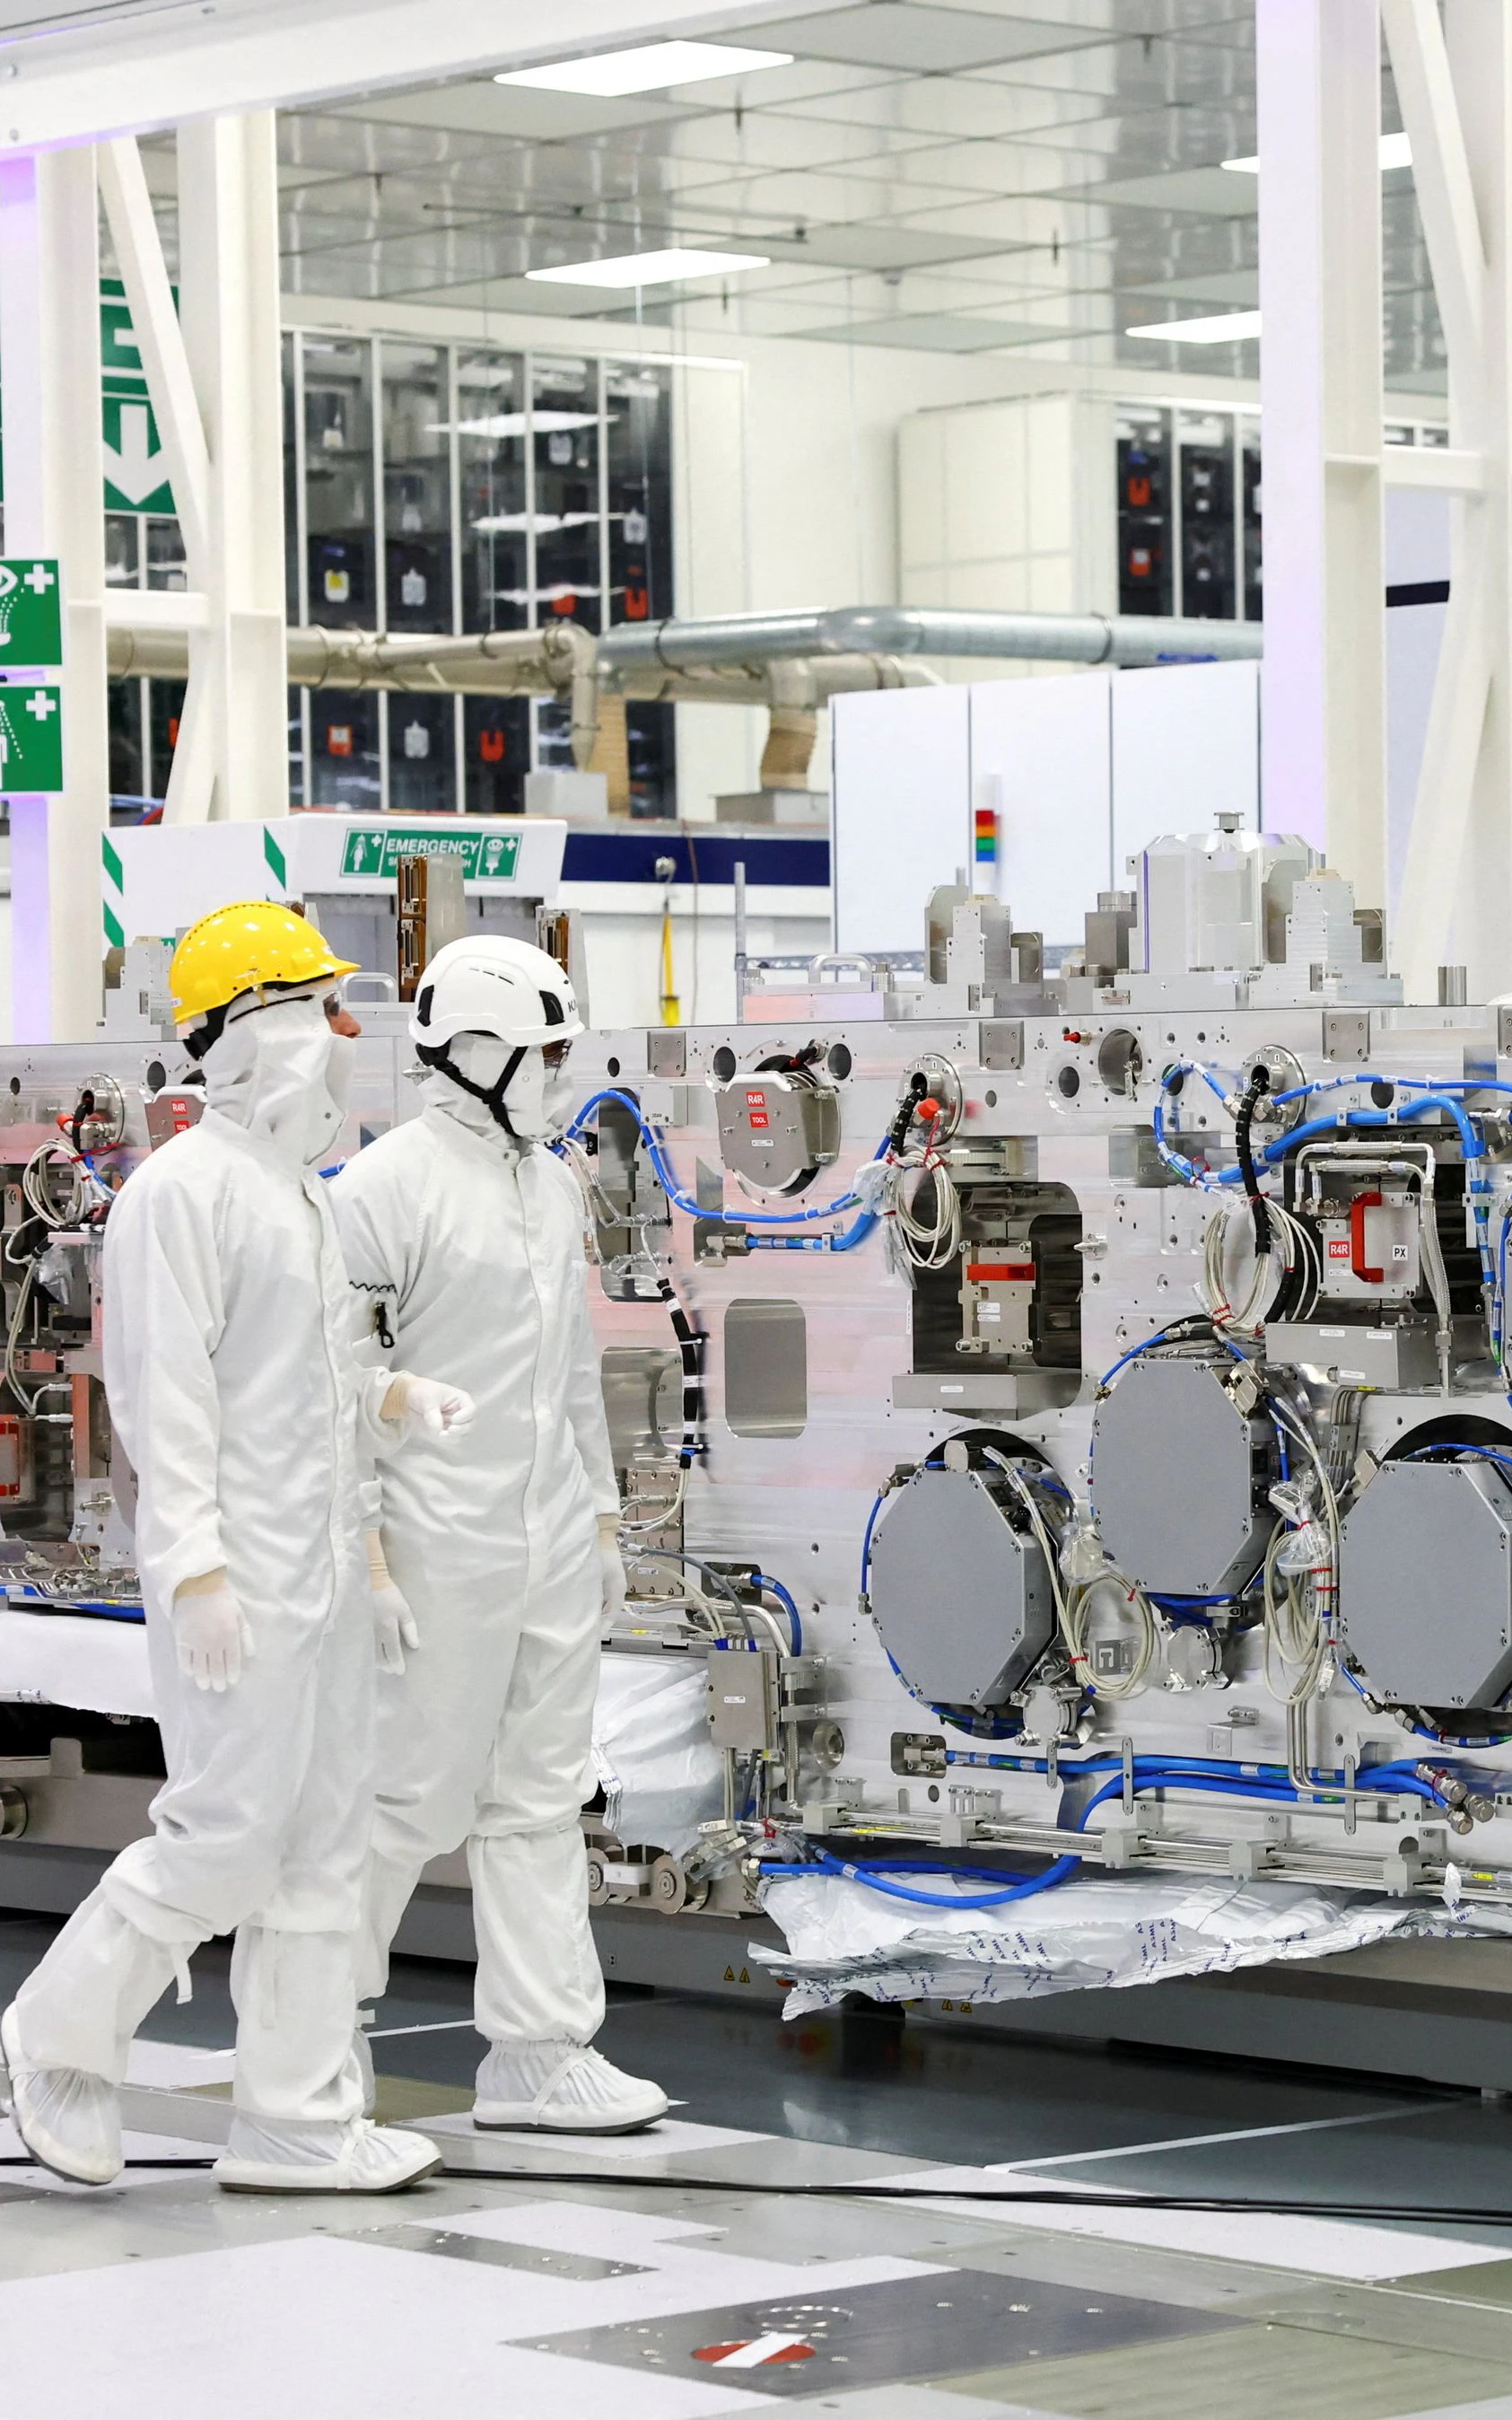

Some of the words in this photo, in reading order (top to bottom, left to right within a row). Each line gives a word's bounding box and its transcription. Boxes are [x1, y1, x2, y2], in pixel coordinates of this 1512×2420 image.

[386, 837, 480, 855] EMERGENCY
[747, 1094, 765, 1105] R4R
[171, 1102, 187, 1112] R4R
[1330, 1243, 1350, 1256] R4R
[1394, 1247, 1406, 1258] PX
